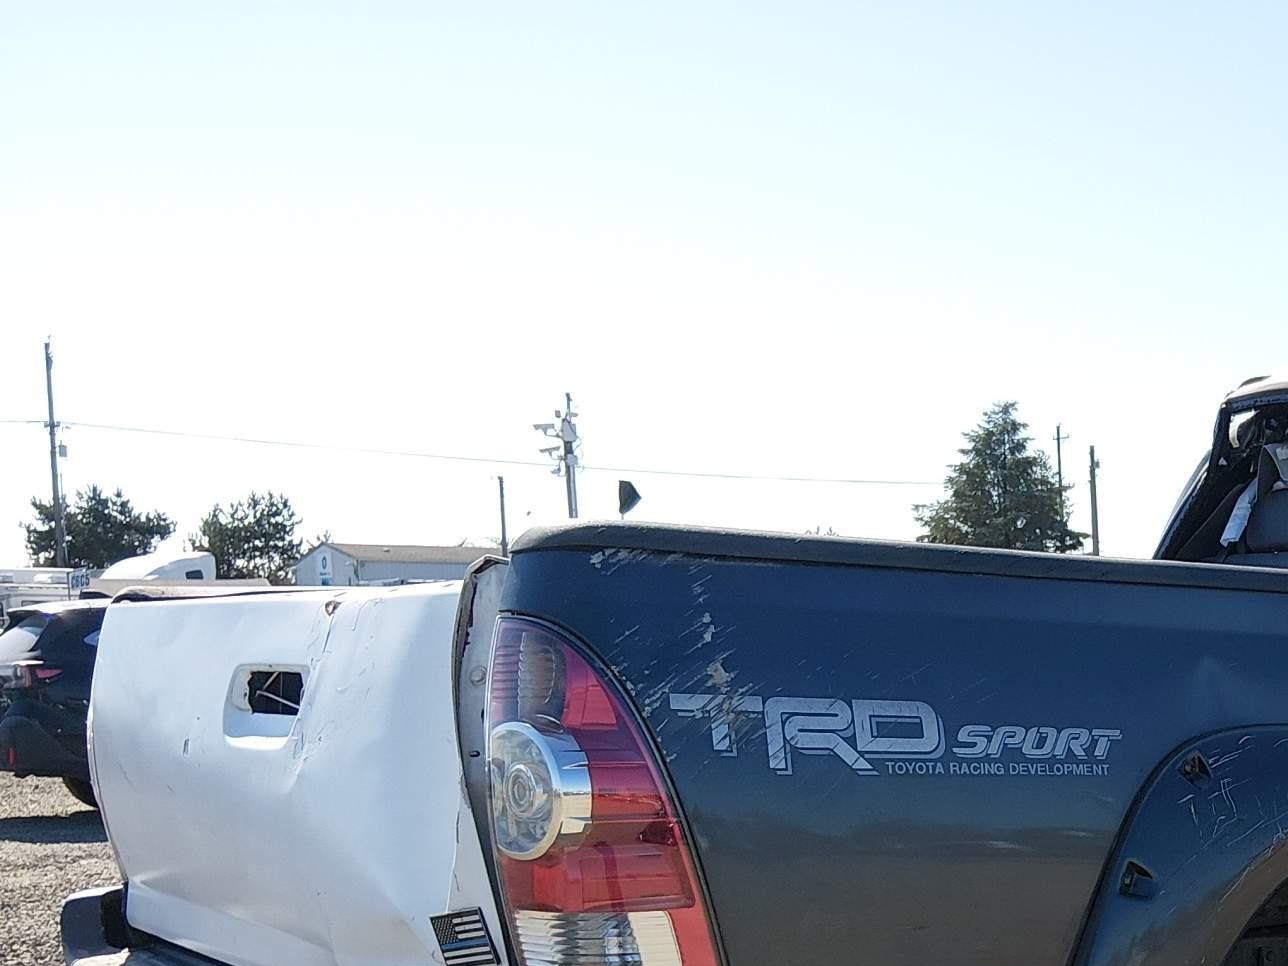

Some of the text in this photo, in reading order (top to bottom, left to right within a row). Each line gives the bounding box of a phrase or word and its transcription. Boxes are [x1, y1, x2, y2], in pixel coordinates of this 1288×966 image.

[669, 692, 1123, 776] TRD SPORT
[885, 760, 1110, 777] TOYOTA RACING DEVELOPMENT
